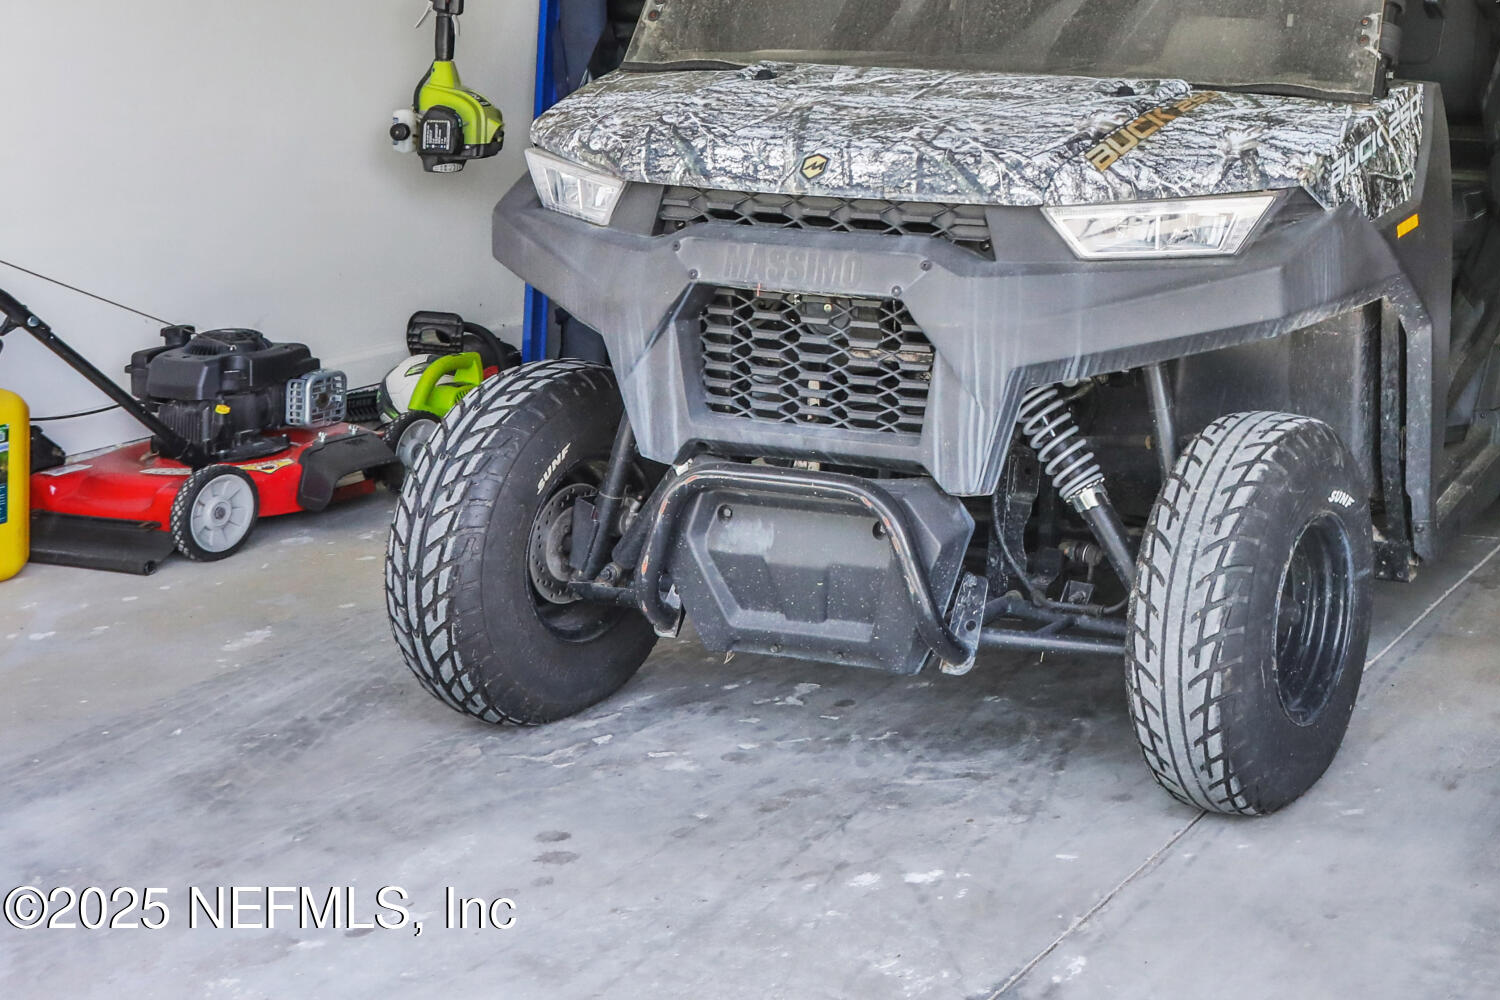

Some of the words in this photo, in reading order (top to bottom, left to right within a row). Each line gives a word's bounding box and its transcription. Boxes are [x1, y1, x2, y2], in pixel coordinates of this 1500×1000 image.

[1084, 106, 1177, 172] BUCK
[1388, 93, 1422, 139] 250
[723, 245, 863, 287] MASSIMO
